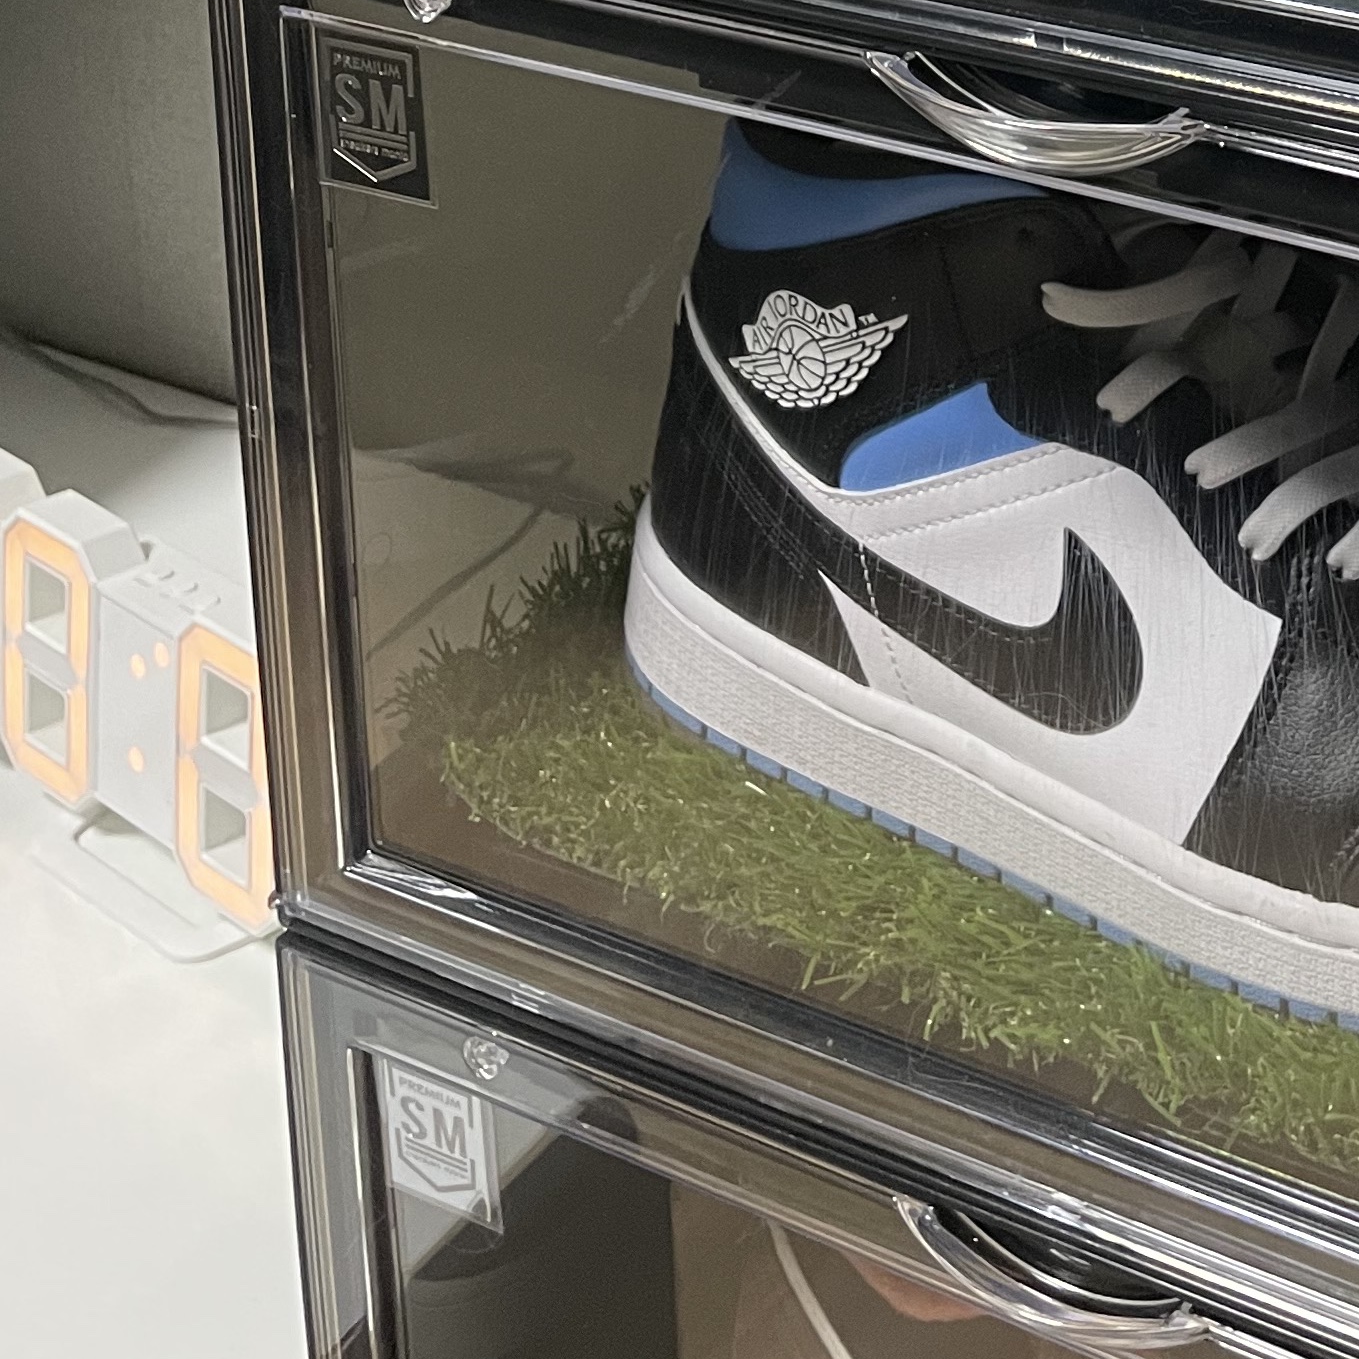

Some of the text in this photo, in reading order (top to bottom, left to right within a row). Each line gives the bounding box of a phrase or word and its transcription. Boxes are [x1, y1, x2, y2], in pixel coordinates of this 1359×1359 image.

[333, 53, 402, 79] PREMIUM
[334, 73, 409, 135] SM
[752, 316, 775, 350] AIR
[400, 1095, 467, 1159] SM
